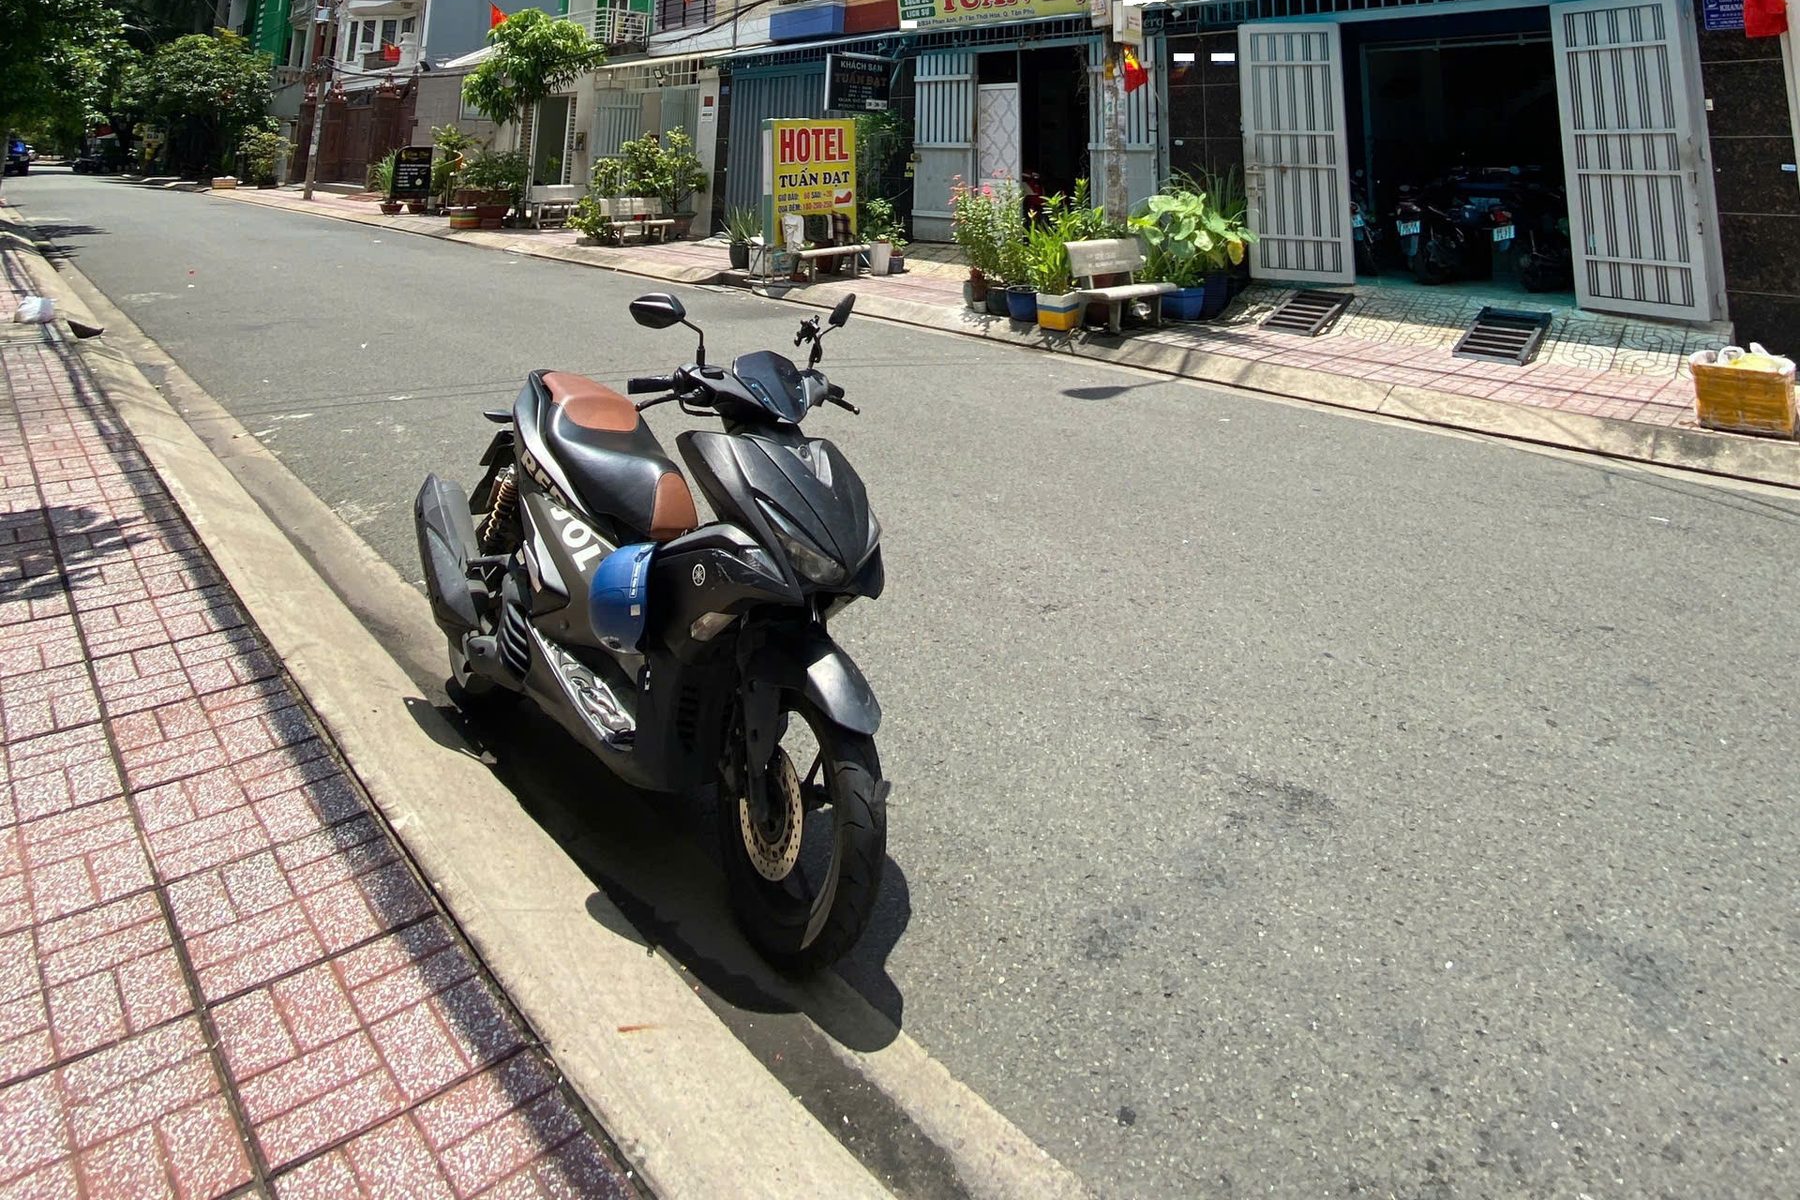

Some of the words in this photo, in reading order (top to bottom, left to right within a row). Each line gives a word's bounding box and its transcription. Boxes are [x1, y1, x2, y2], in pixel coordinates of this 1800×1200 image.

[779, 127, 850, 164] HOTEL
[779, 167, 819, 188] TUẤN
[822, 171, 850, 187] ĐẠT
